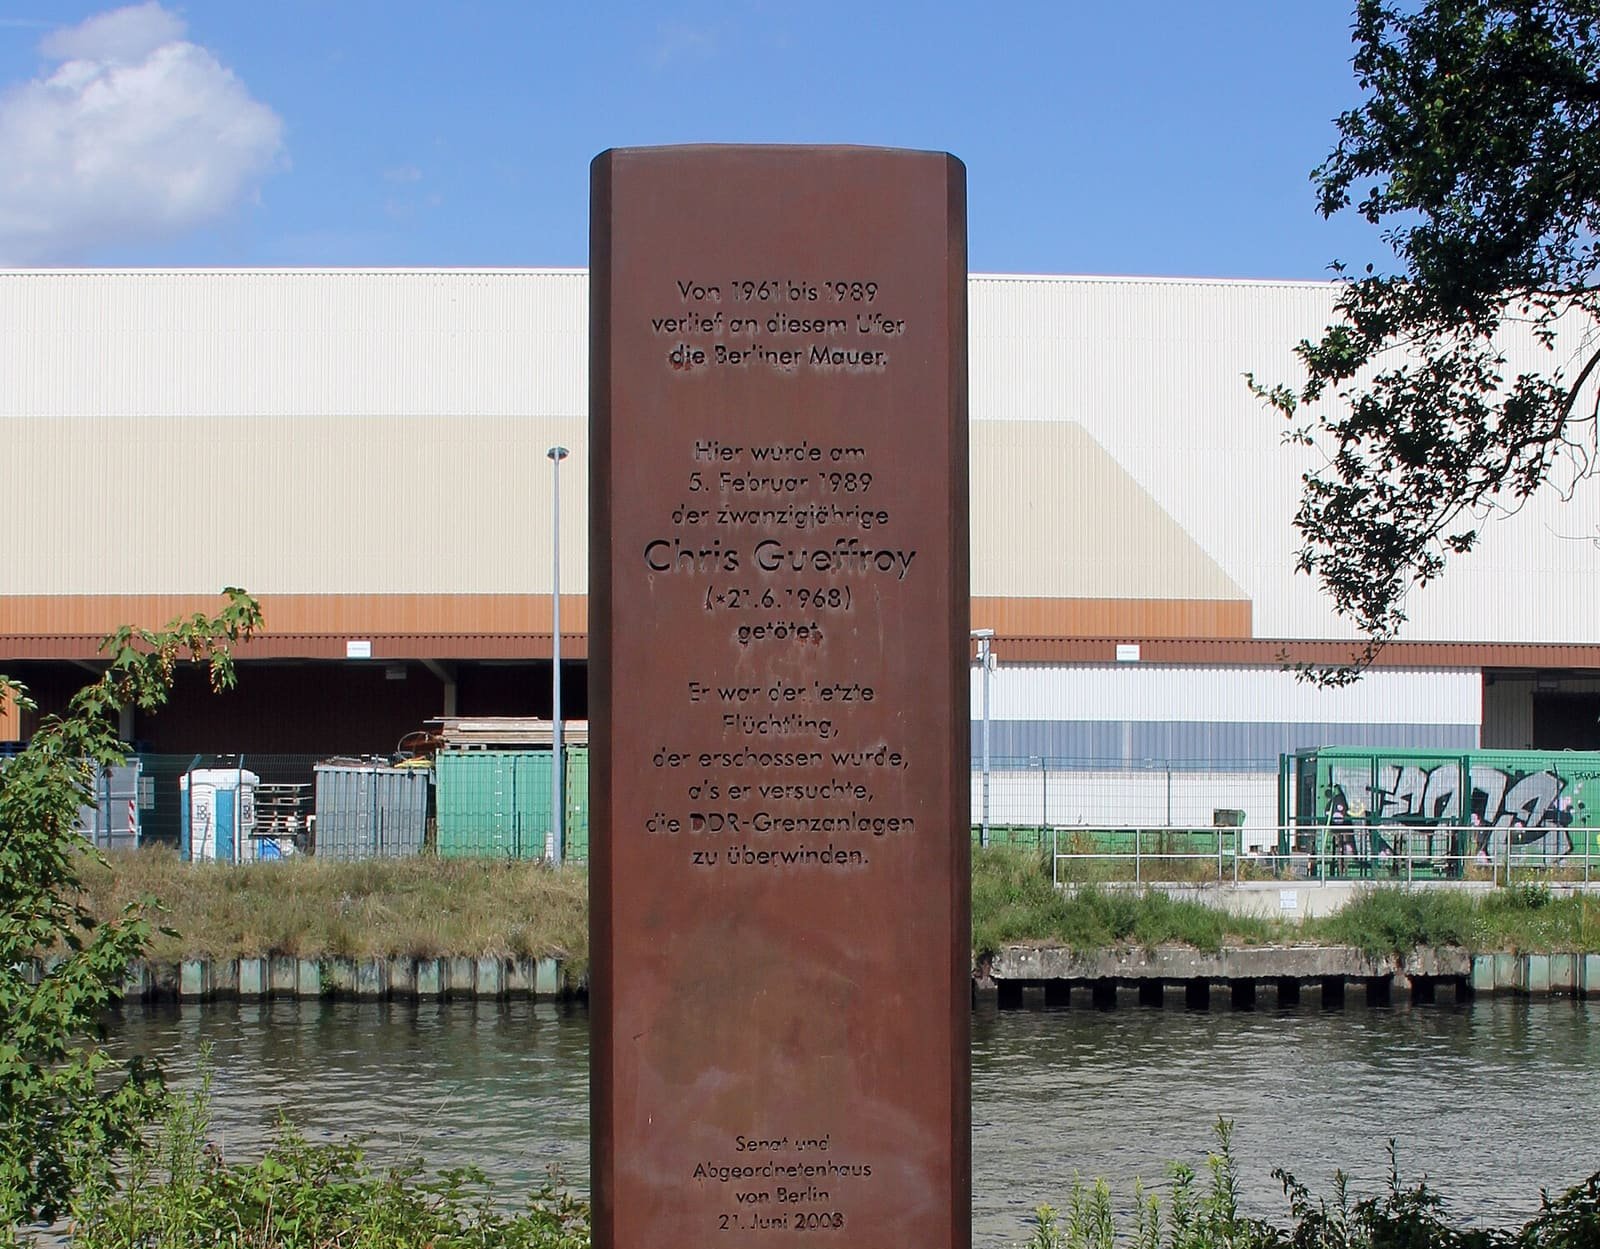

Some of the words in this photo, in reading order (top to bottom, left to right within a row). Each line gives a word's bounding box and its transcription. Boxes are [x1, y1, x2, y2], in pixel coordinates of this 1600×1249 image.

[677, 281, 720, 301] Von
[732, 281, 779, 301] 1961
[789, 281, 818, 301] bis
[826, 281, 878, 301] 1989
[652, 312, 722, 334] verlief
[730, 317, 758, 334] an
[767, 312, 847, 334] diesem
[857, 313, 904, 334] Ufer
[671, 344, 705, 365] die
[715, 345, 802, 365] Berliner
[810, 346, 887, 366] Mauer.
[695, 441, 743, 461] Hier
[750, 442, 821, 461] wurde
[830, 446, 865, 461] am
[688, 472, 708, 492] 5.
[720, 472, 808, 492] Februar
[819, 472, 872, 492] 1989
[672, 505, 709, 525] der
[717, 505, 889, 529] zwanzigjährige
[644, 538, 739, 572] Chris
[754, 538, 917, 580] Gueffroy
[738, 621, 823, 645] getötet.
[688, 682, 710, 701] Er
[718, 686, 761, 701] war
[768, 682, 806, 701] der
[814, 681, 874, 701] letzte
[723, 714, 839, 738] Flüchtling,
[653, 747, 691, 768] der
[699, 747, 822, 768] erschossen
[831, 747, 909, 770] wurde,
[688, 779, 719, 800] als
[728, 784, 751, 800] er
[758, 779, 874, 802] versuchte,
[646, 812, 680, 833] die
[690, 812, 915, 837] DDR-Grenzanlagen
[693, 850, 718, 865] zu
[728, 845, 869, 866] überwinden.
[736, 1136, 788, 1152] Senat
[795, 1134, 829, 1152] und
[693, 1161, 872, 1180] Abgeordnetenhaus
[736, 1191, 770, 1203] von
[777, 1187, 829, 1203] Berlin
[719, 1213, 745, 1230] 21.
[750, 1213, 788, 1230] Juni
